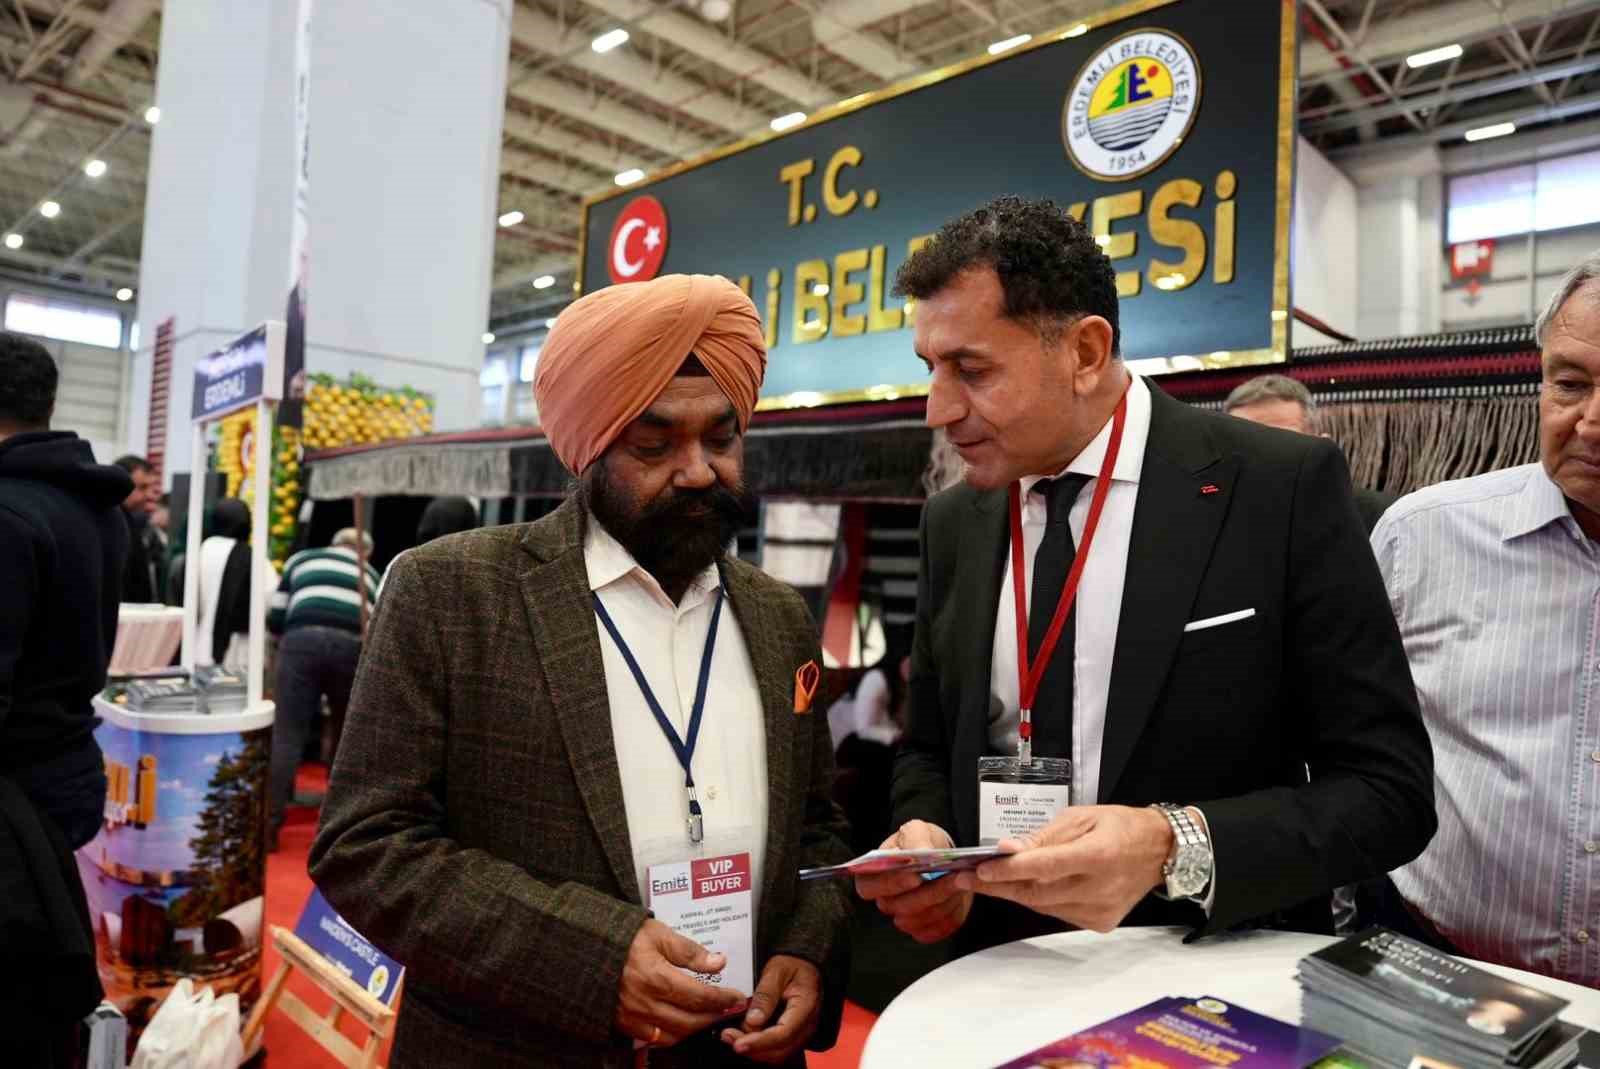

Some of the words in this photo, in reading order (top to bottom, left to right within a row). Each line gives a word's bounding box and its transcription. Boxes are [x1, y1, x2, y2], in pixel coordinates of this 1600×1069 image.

[1108, 151, 1147, 170] 1954
[780, 146, 880, 226] T.C.
[709, 859, 734, 875] VIP
[652, 875, 688, 893] Emitt
[701, 877, 742, 894] BUYER
